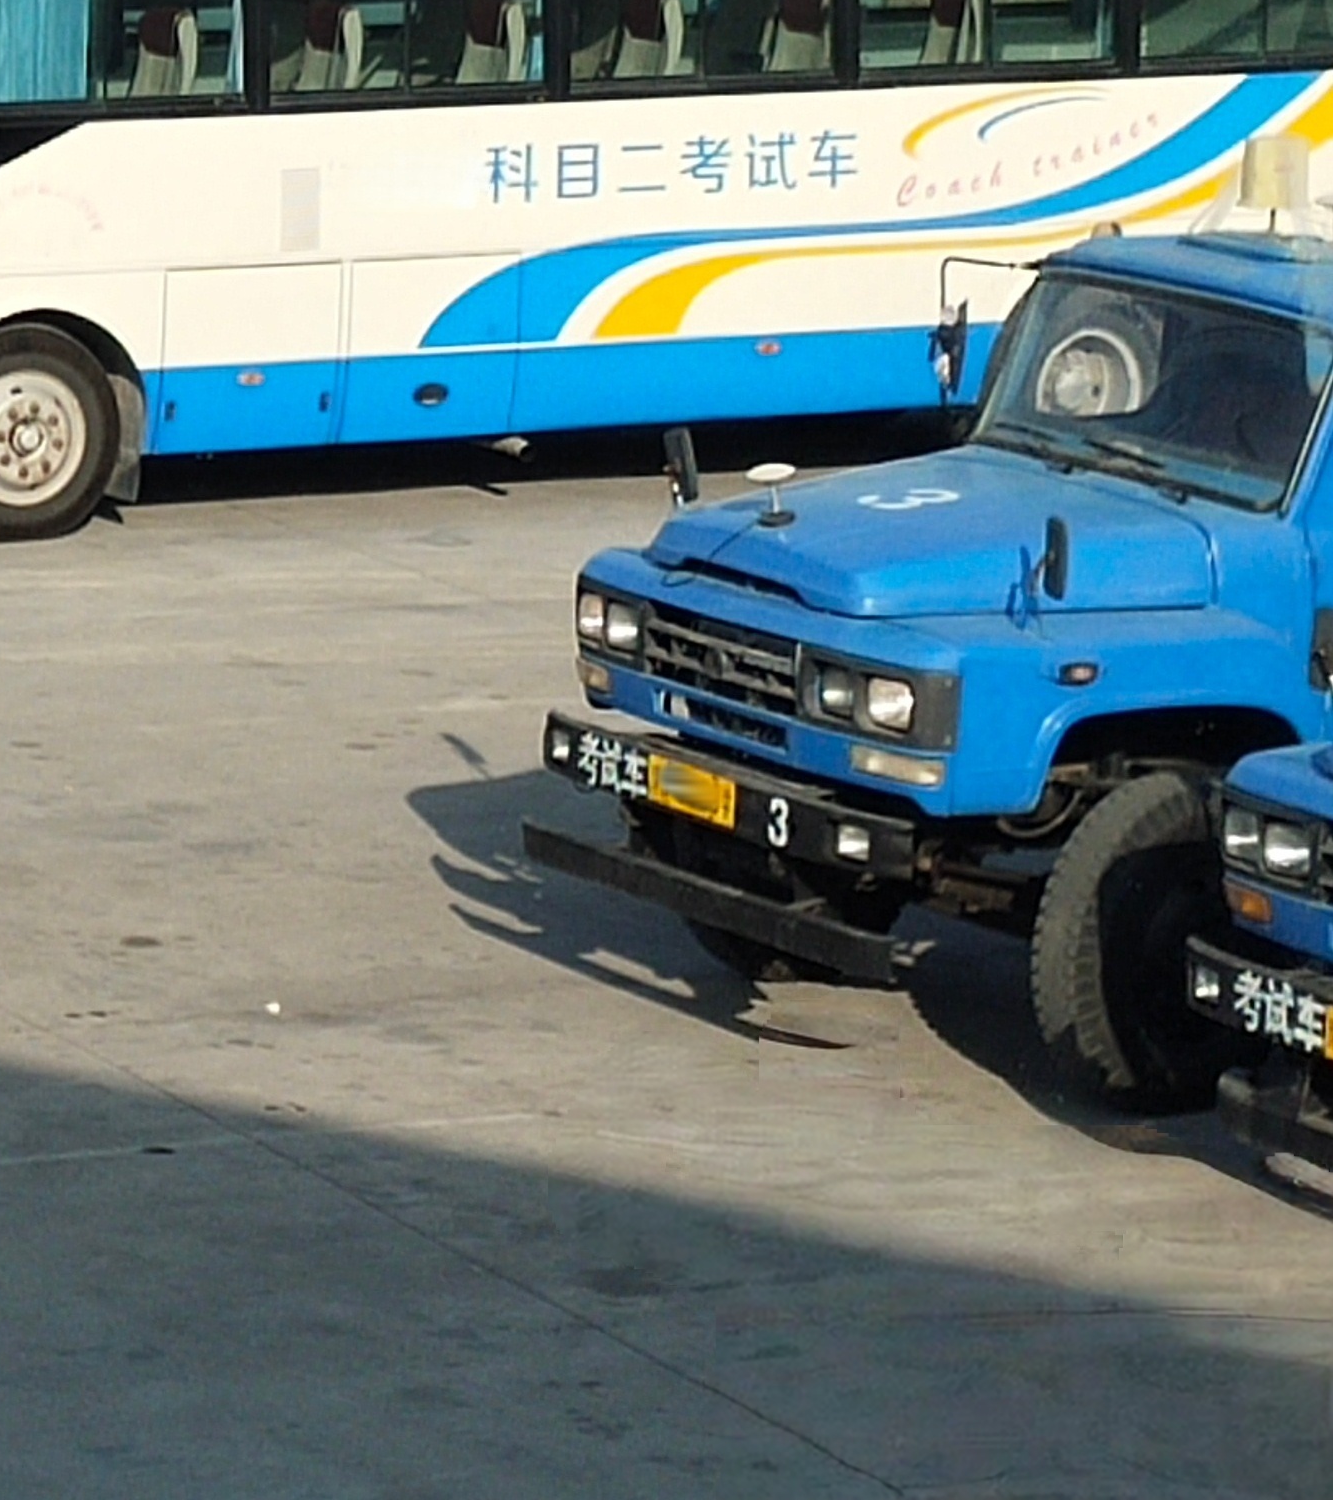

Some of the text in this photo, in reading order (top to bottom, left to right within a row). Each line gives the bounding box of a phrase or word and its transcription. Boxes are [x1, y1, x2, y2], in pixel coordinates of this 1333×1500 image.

[484, 130, 858, 203] 科目二考试车
[896, 112, 1158, 207] Coach trainer
[856, 488, 960, 510] 3
[577, 730, 649, 800] 考试车
[767, 796, 790, 849] 3
[1233, 969, 1327, 1053] 考试车
